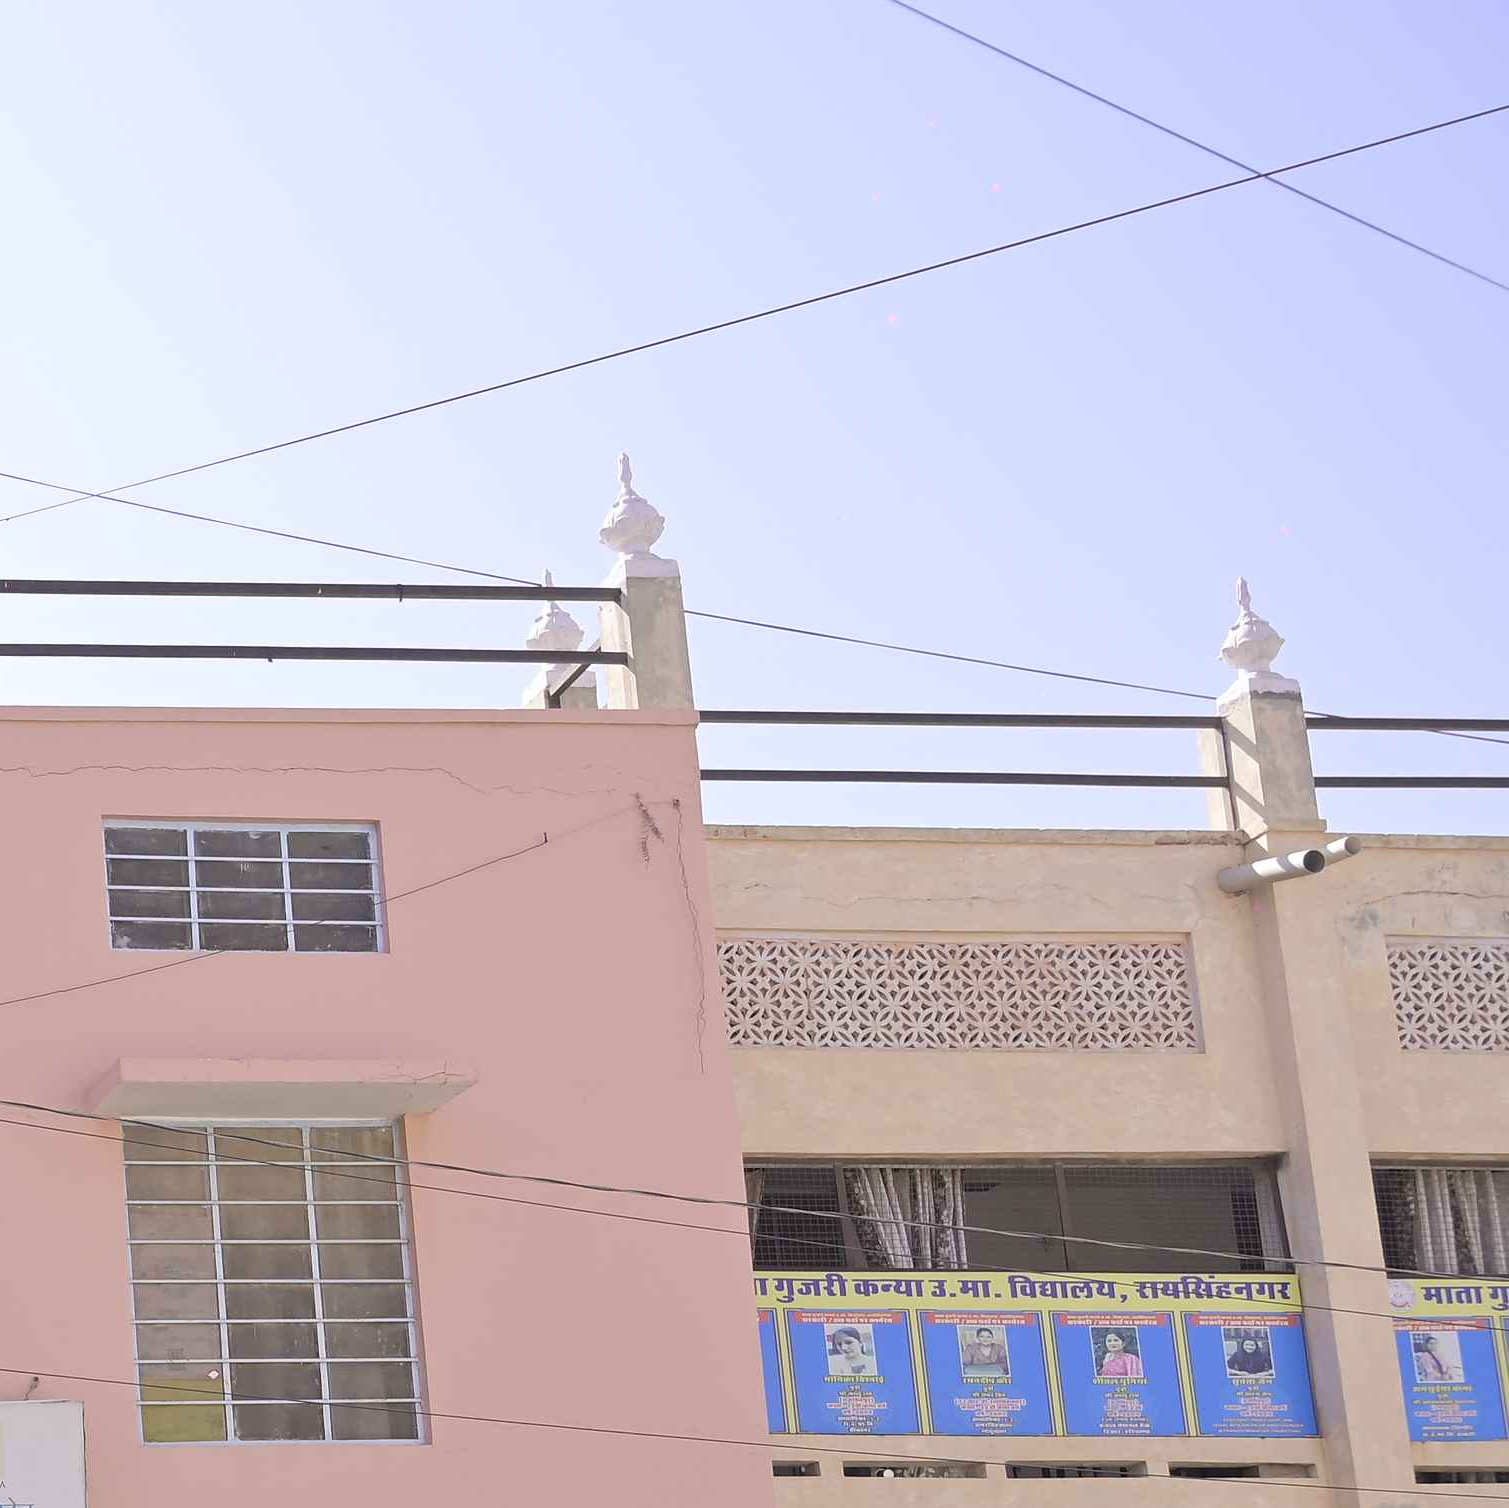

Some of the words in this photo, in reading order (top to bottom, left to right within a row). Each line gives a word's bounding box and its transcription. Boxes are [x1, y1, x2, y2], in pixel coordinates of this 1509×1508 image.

[774, 1272, 848, 1303] गुजरी
[852, 1279, 925, 1298] कन्या
[1007, 1275, 1128, 1302] विद्यालय,
[1134, 1275, 1292, 1301] रायसिंहनगर
[1422, 1286, 1483, 1305] माता
